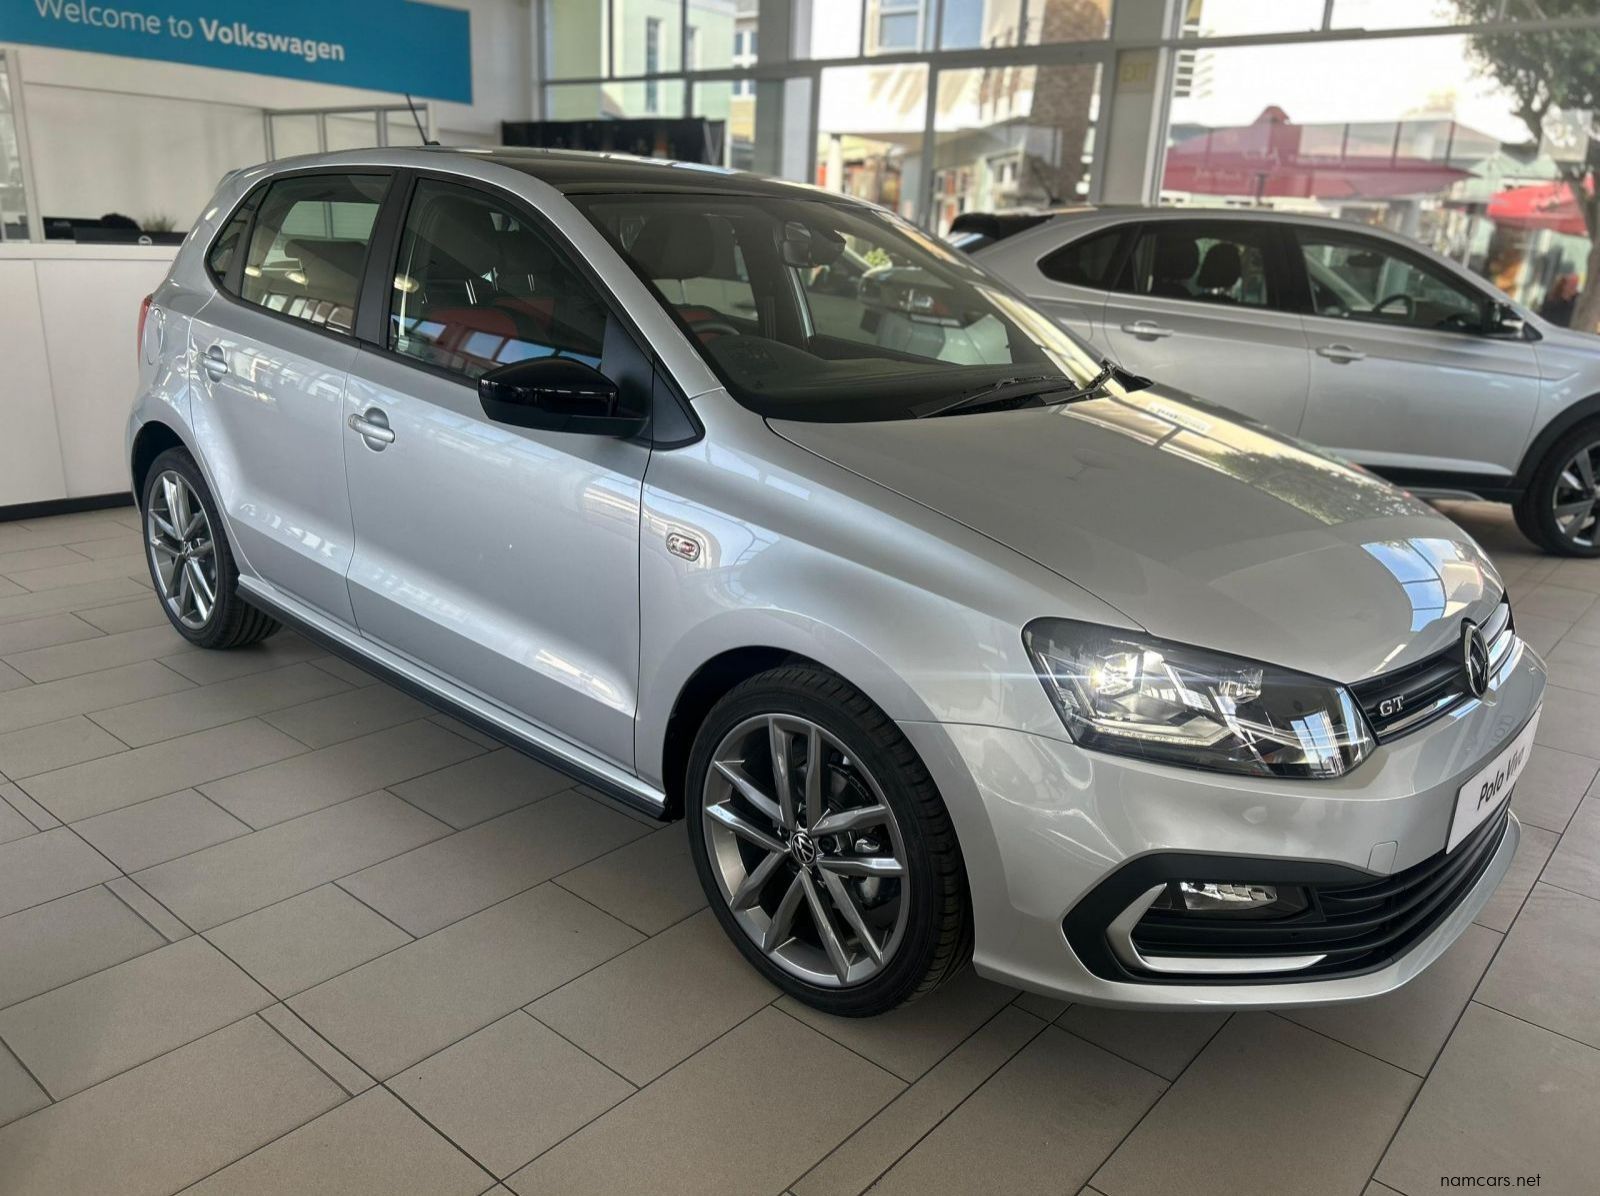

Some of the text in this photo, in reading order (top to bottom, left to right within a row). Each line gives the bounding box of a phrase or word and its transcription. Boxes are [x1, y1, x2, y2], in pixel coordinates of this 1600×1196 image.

[35, 0, 345, 62] Welcome to Volkswagen
[1380, 695, 1404, 717] GT
[1476, 770, 1505, 811] Polo
